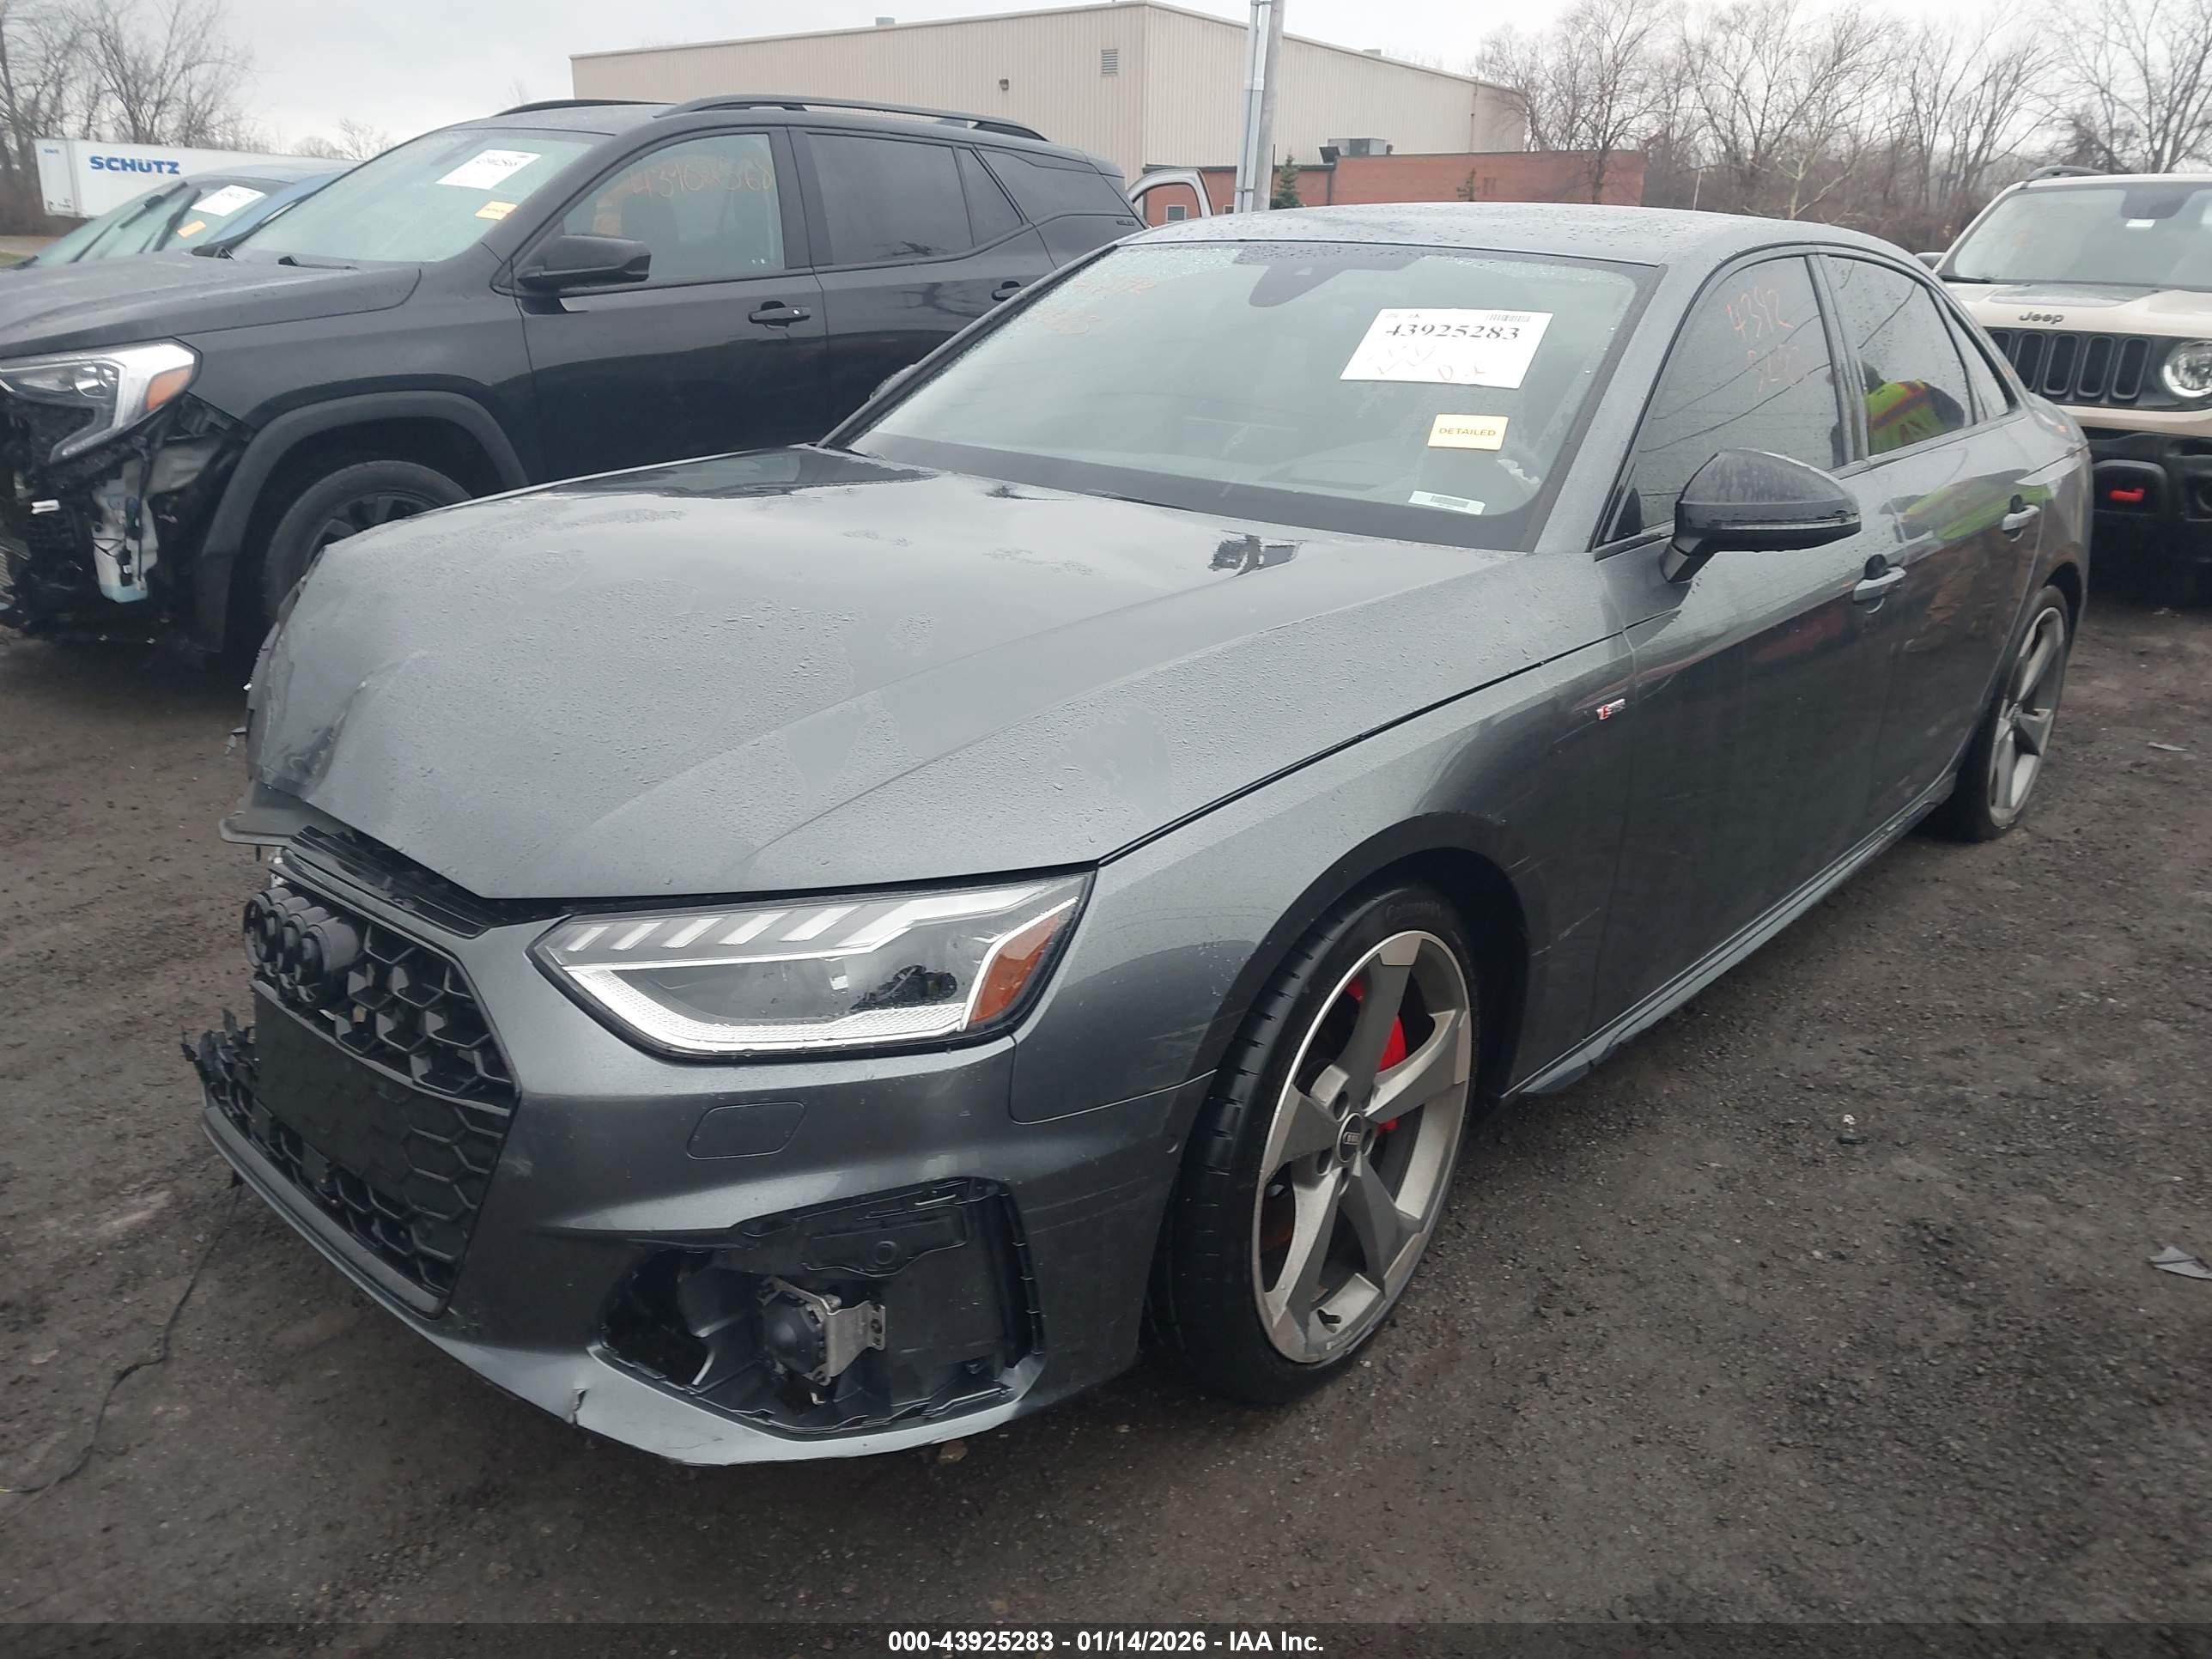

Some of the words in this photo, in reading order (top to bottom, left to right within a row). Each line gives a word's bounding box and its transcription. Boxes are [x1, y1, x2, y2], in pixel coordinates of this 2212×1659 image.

[89, 155, 180, 174] SCHÜTZ
[2019, 311, 2065, 325] Jeep
[1385, 324, 1520, 340] 43925283
[1439, 427, 1497, 437] DETAILED
